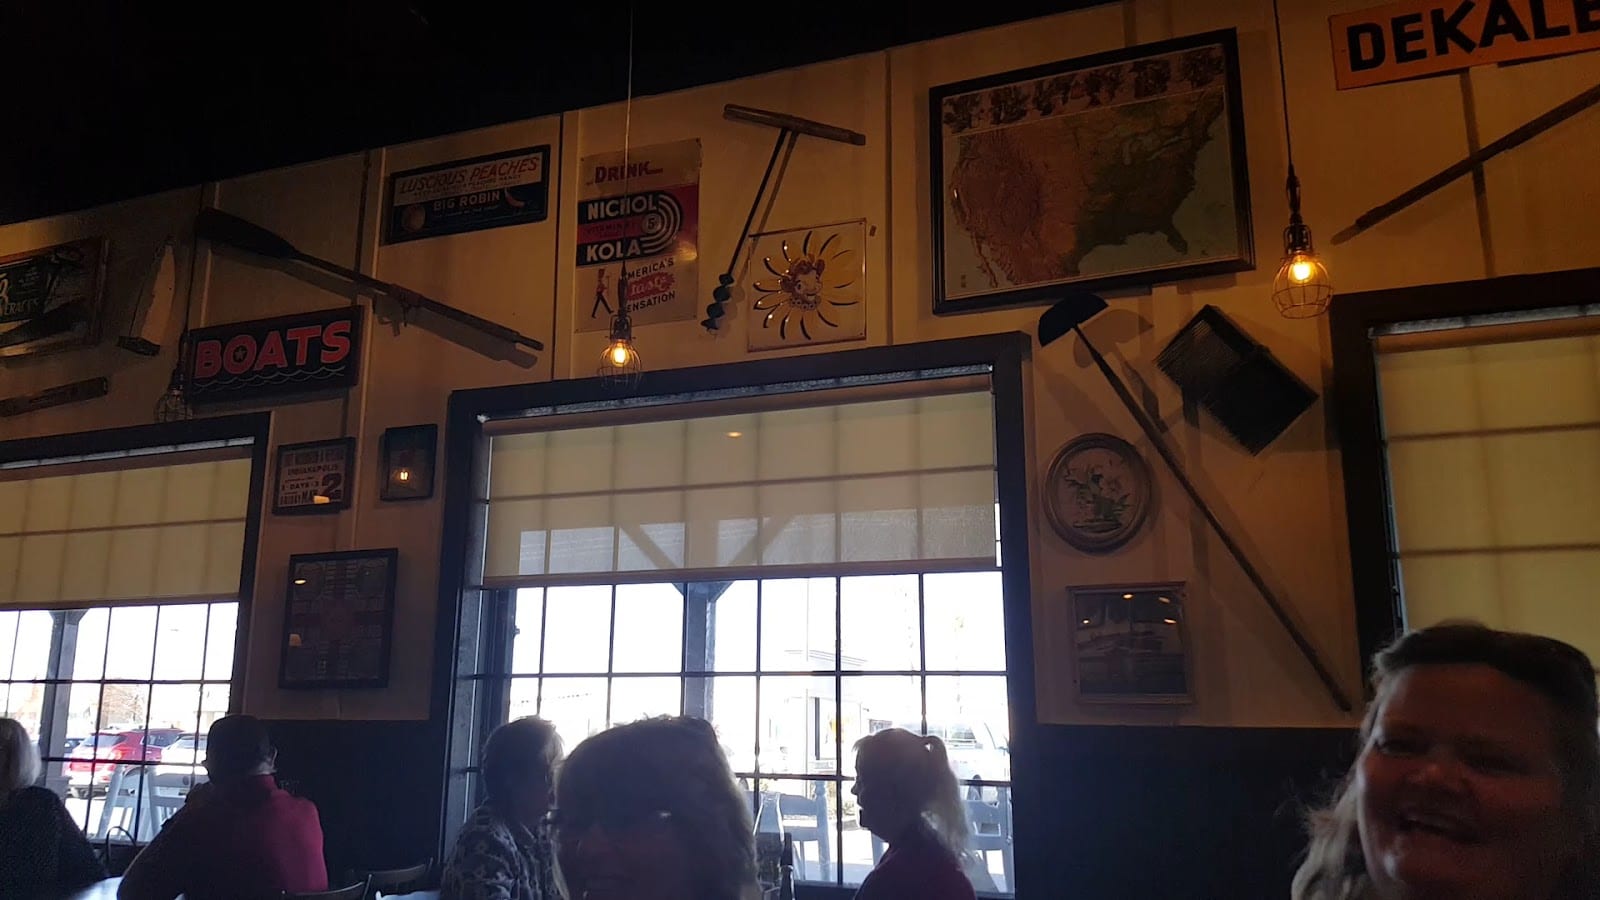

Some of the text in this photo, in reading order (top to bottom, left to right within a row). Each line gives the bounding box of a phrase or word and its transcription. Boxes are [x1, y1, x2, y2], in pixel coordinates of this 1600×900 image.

[400, 169, 467, 194] LUSCIOUS
[470, 156, 540, 181] PEACHES
[595, 161, 652, 183] DRINK
[433, 197, 456, 212] BIG
[459, 190, 501, 207] ROBIN
[587, 193, 658, 221] NICHOL
[586, 239, 641, 263] KOLA
[626, 290, 676, 312] ENSATION
[194, 319, 352, 380] BOATS
